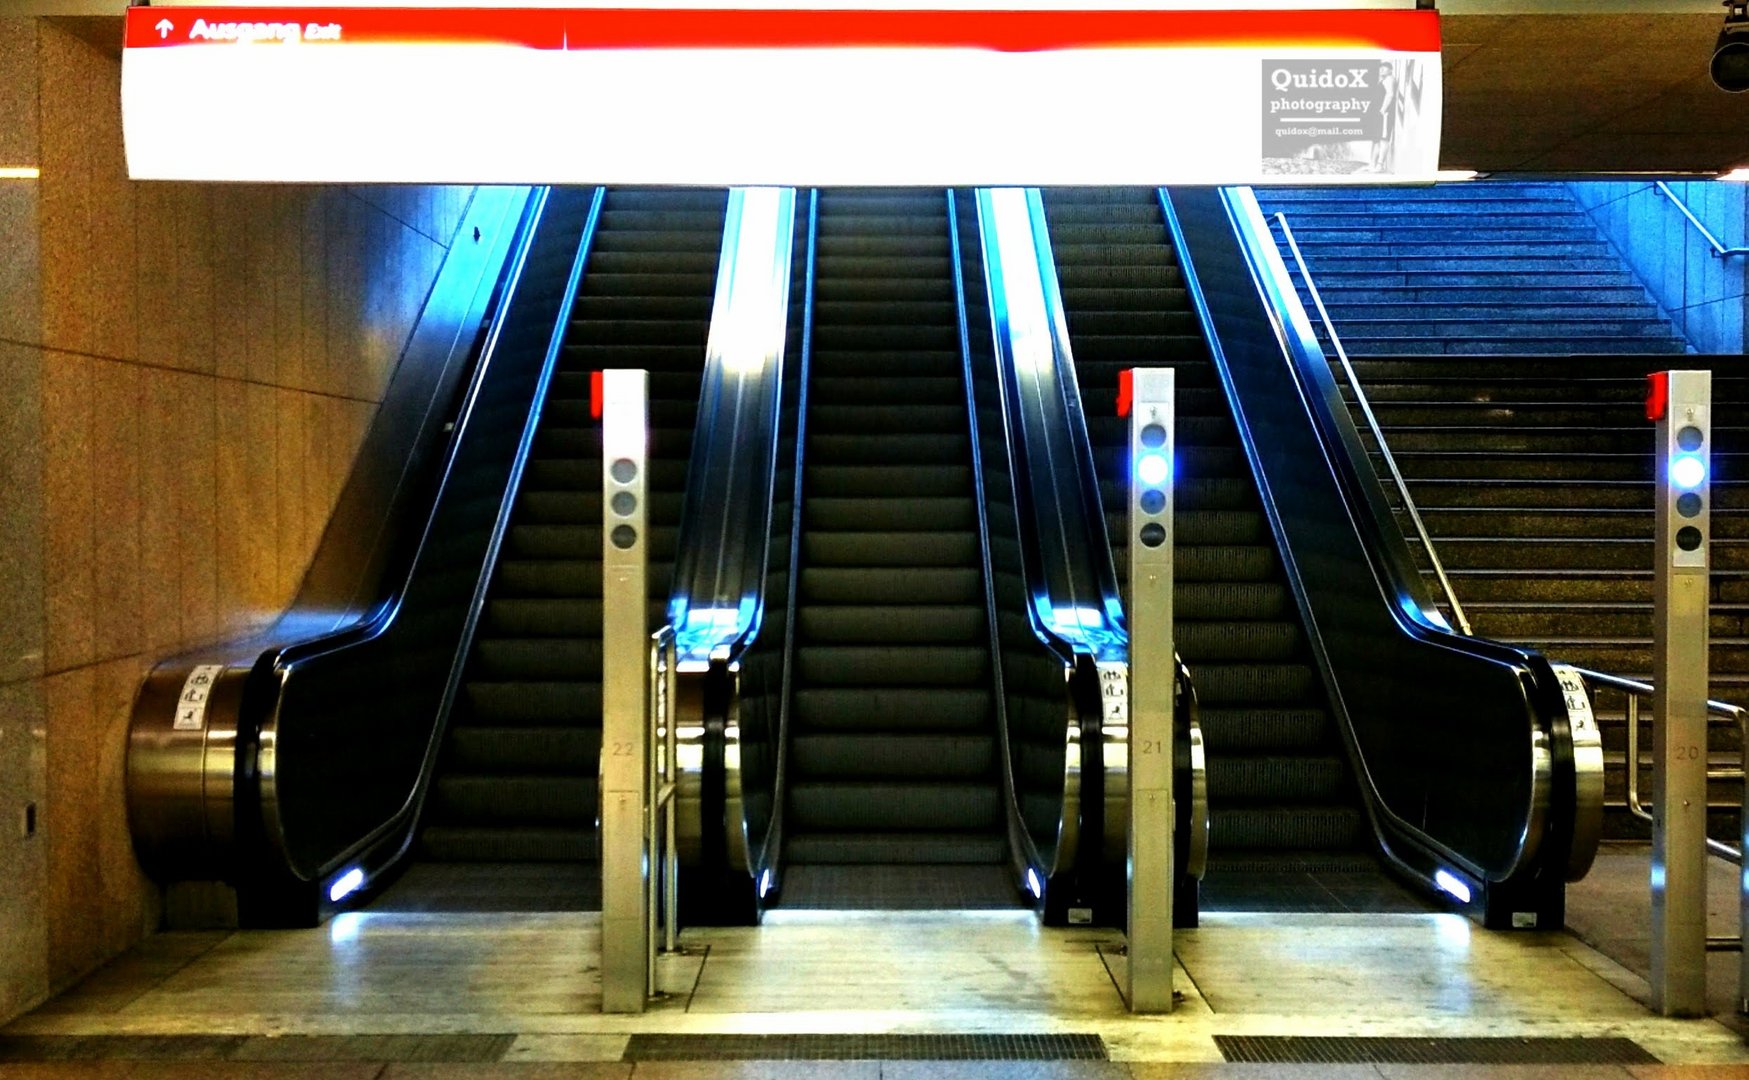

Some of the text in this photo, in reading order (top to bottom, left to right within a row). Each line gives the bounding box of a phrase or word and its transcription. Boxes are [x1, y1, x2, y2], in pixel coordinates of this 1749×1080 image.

[189, 18, 342, 43] Ausgang Exit
[612, 742, 632, 756] 22
[1142, 740, 1162, 754] 21
[1676, 745, 1699, 760] 20
